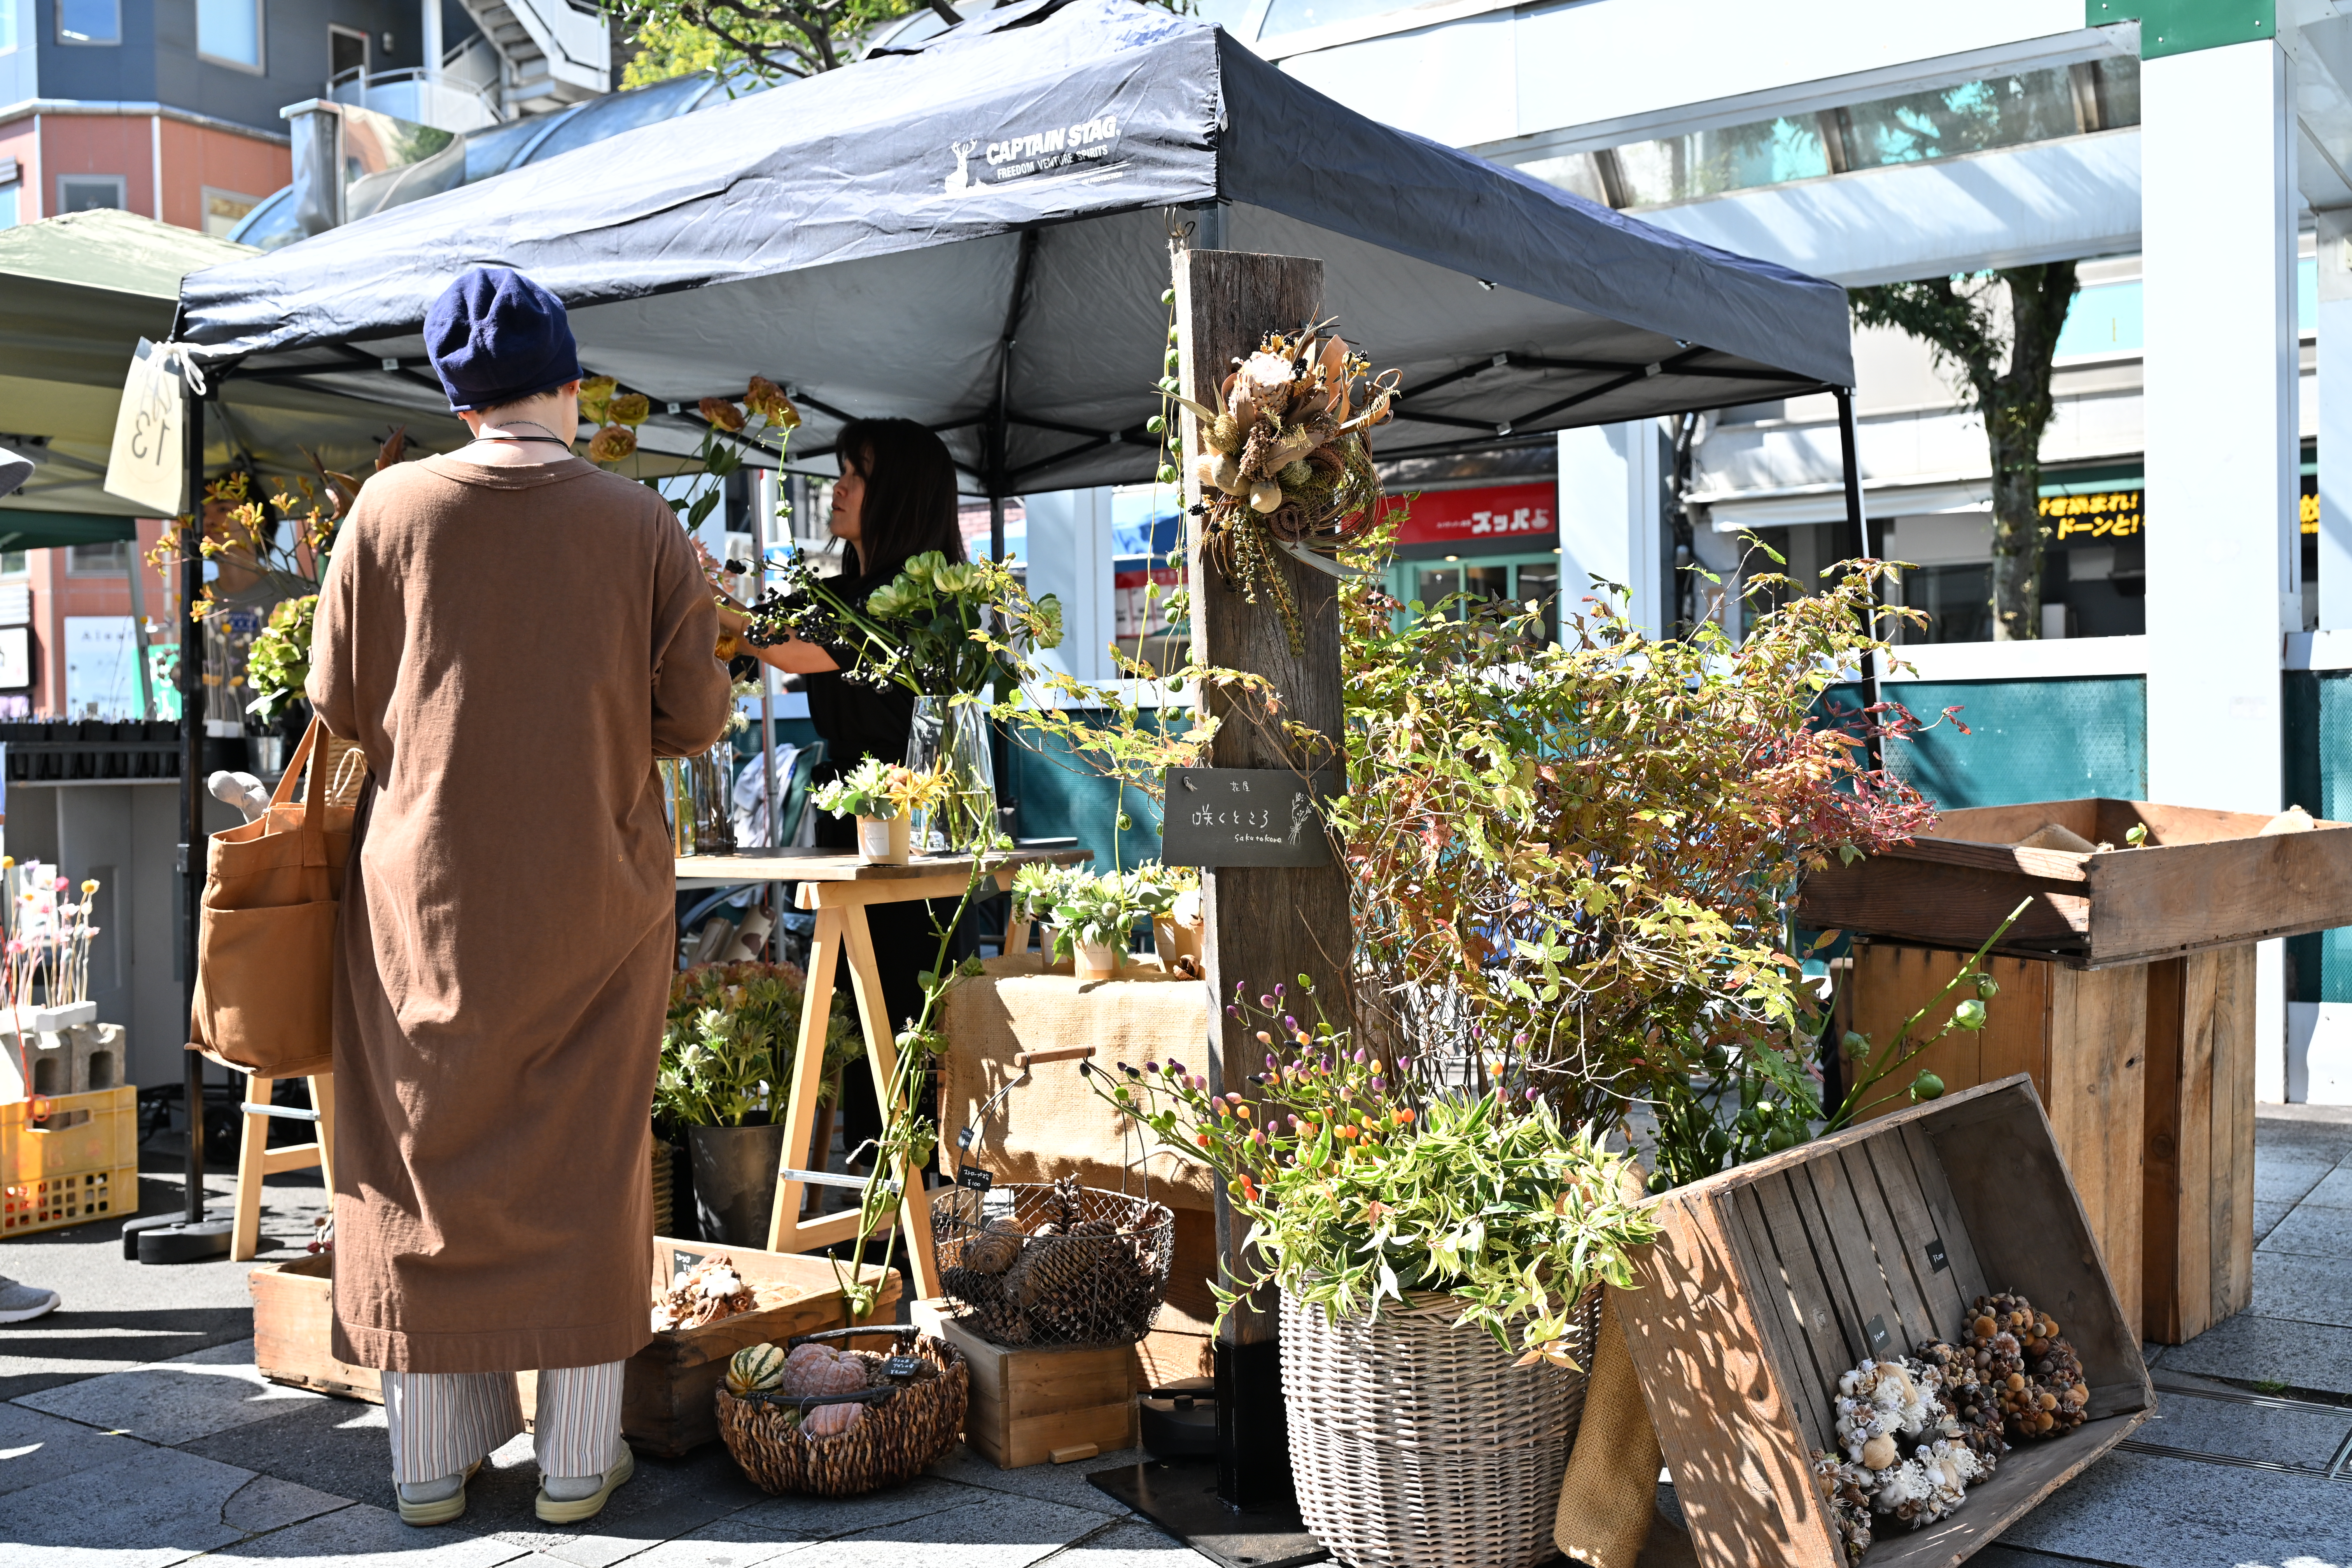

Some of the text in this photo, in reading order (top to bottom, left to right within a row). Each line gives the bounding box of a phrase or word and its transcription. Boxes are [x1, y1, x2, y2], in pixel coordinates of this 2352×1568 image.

[986, 116, 1116, 165] CAPTAIN STAG
[997, 144, 1108, 179] FREEDOM VENTURE SPIRITS
[1090, 171, 1123, 184] PROTECTION
[1230, 781, 1251, 792] 花屋
[1192, 803, 1268, 828] 咲くところ
[968, 1178, 981, 1186] ¥100
